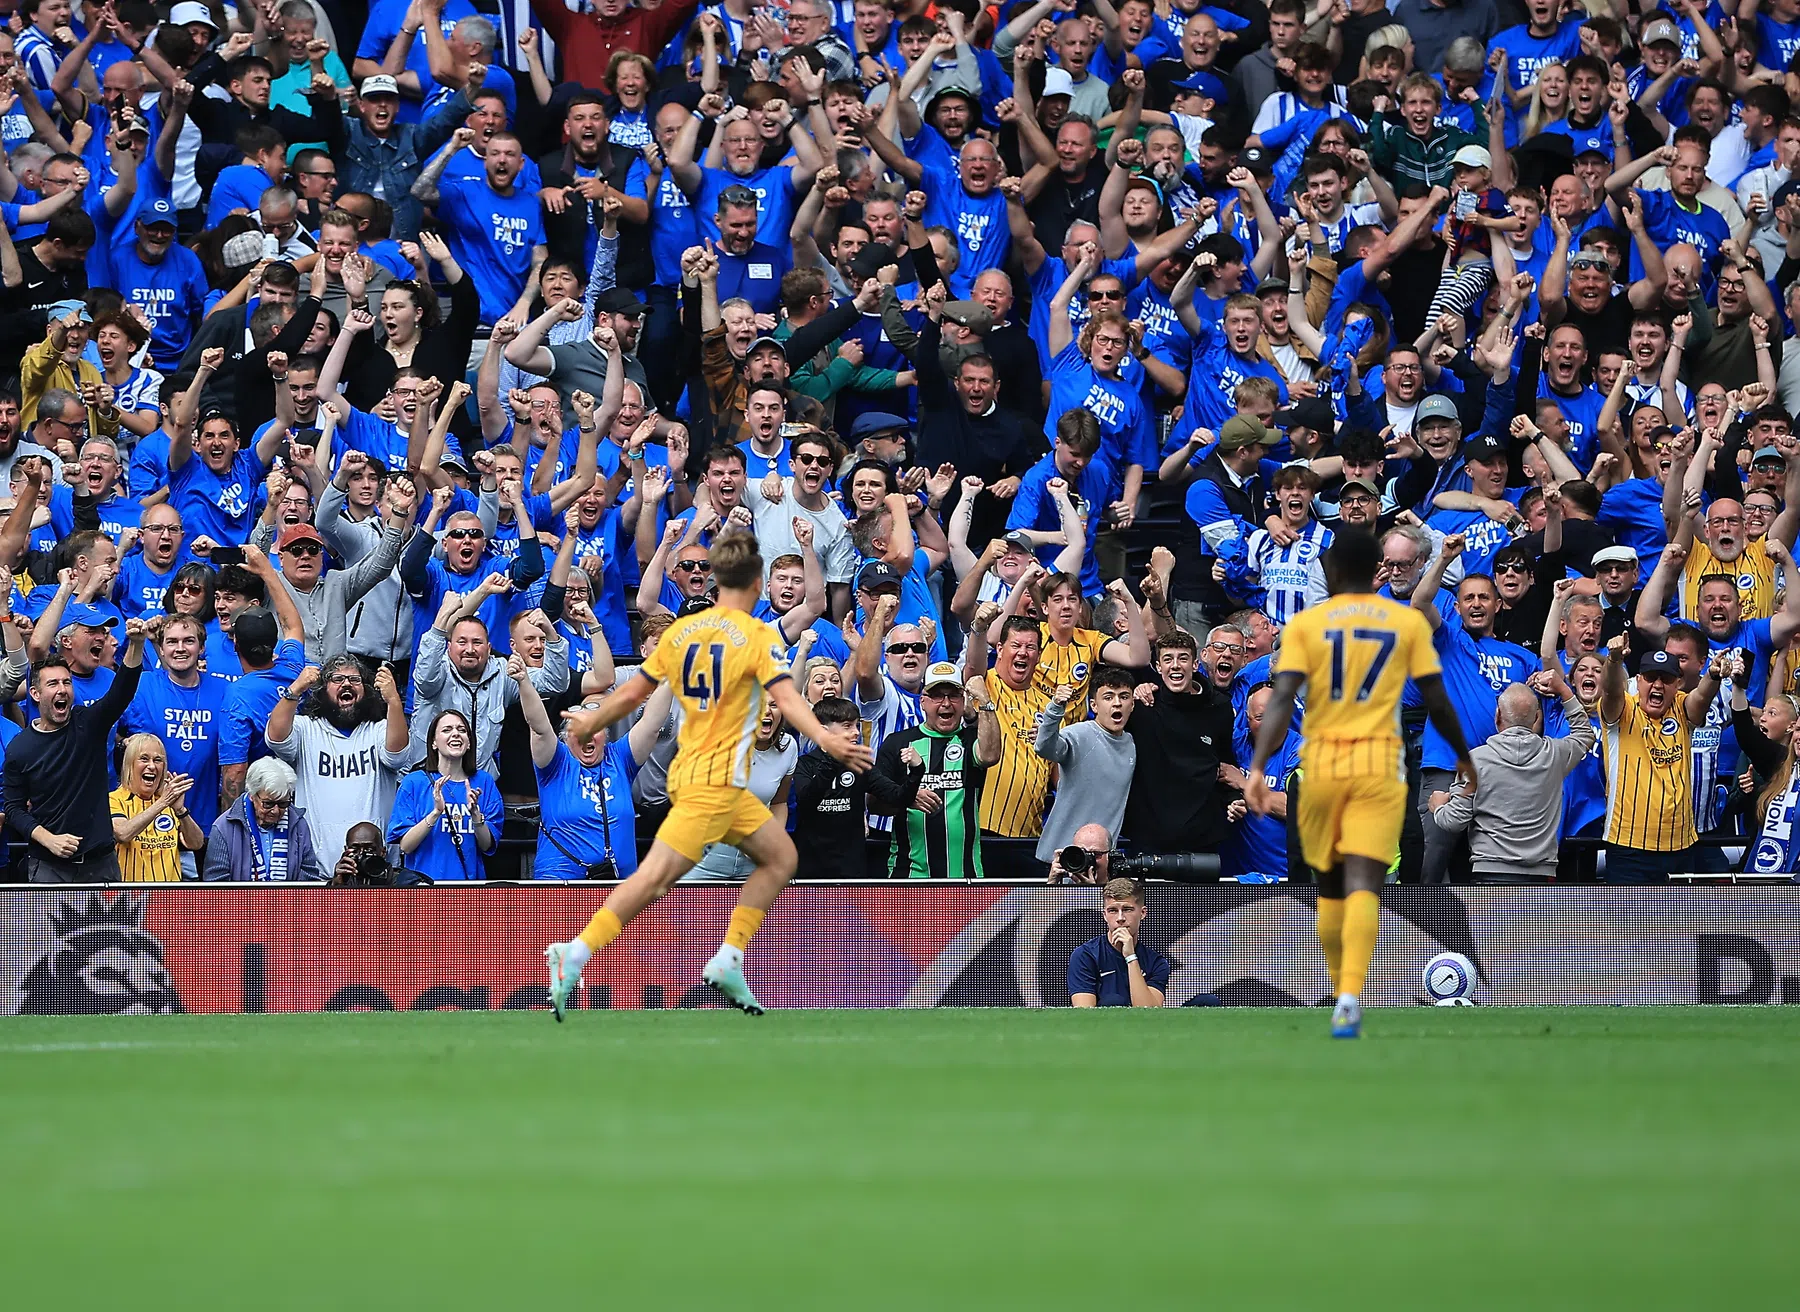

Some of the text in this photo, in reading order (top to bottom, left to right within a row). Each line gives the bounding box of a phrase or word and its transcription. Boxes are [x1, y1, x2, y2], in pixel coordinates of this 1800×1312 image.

[1520, 71, 1539, 86] FA
[958, 212, 990, 227] STAN
[958, 223, 984, 241] FAL
[131, 288, 175, 300] STAND
[1140, 296, 1178, 321] STAND
[1221, 366, 1246, 388] STA
[1218, 376, 1237, 399] FA
[1089, 384, 1125, 412] STAND
[1082, 394, 1117, 427] FALL
[387, 452, 409, 467] STA
[1464, 529, 1504, 552] FALL
[142, 586, 168, 600] STA
[1325, 629, 1397, 703] 17
[682, 643, 725, 708] 41
[163, 707, 213, 723] STAND
[166, 724, 208, 740] FALL
[1650, 743, 1683, 758] MERICAN
[1692, 740, 1720, 748] PRESS
[1653, 752, 1684, 765] XPRESS
[1765, 794, 1786, 833] BION
[141, 841, 177, 851] EXPRESS
[269, 838, 289, 881] ALBIO
